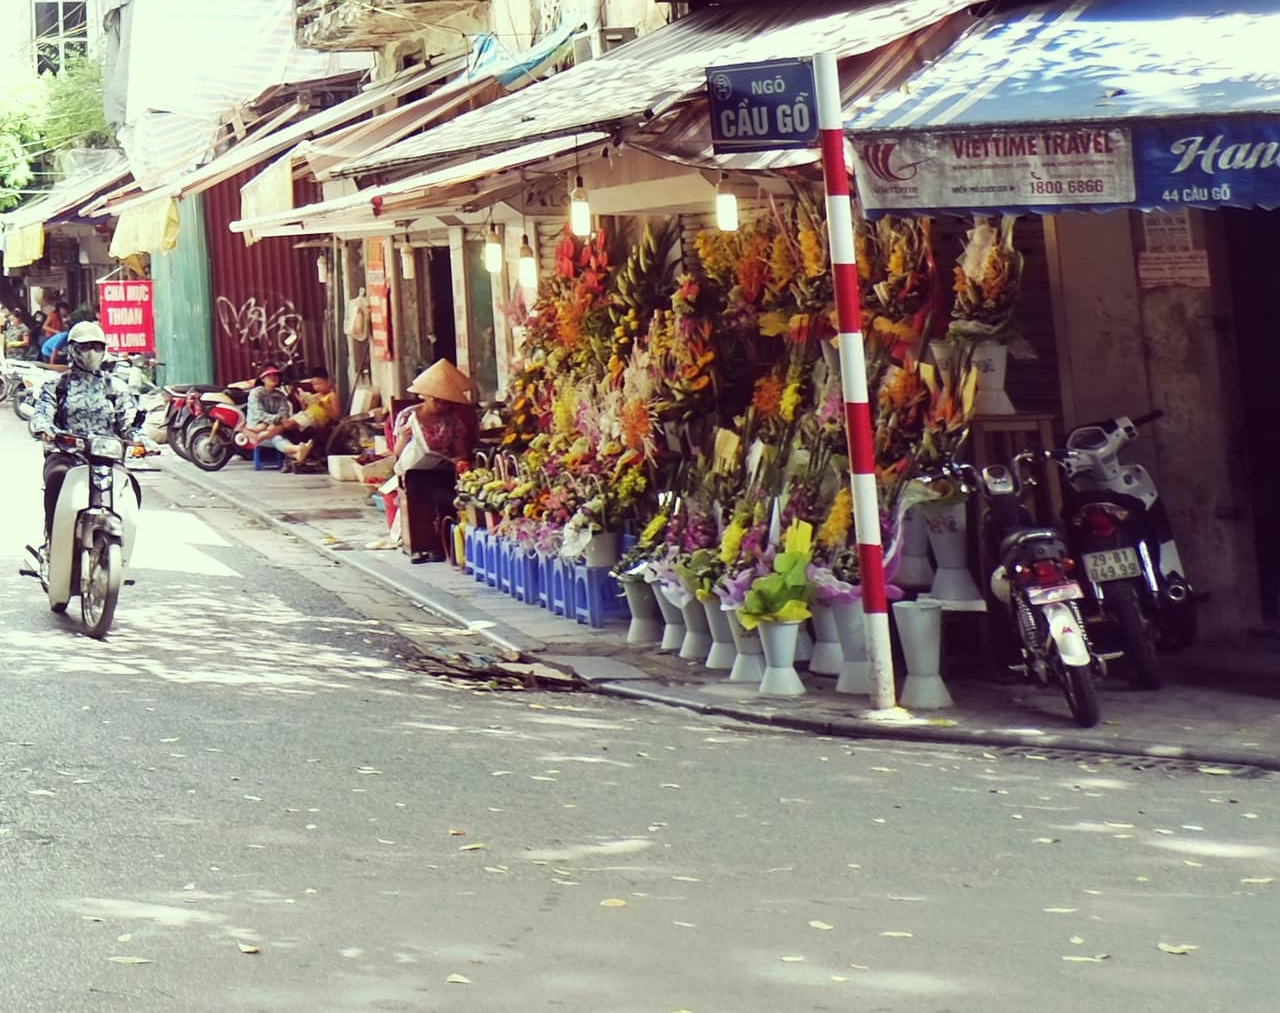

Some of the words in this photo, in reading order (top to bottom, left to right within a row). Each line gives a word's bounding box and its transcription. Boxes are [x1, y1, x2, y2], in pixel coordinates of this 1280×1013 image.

[751, 75, 785, 95] NGÕ
[720, 99, 768, 138] CẦU
[776, 92, 810, 134] GỖ
[951, 136, 1038, 159] VIETTIME
[1042, 132, 1115, 156] TRAVEL
[1030, 180, 1063, 194] 1800
[1162, 189, 1180, 203] 44
